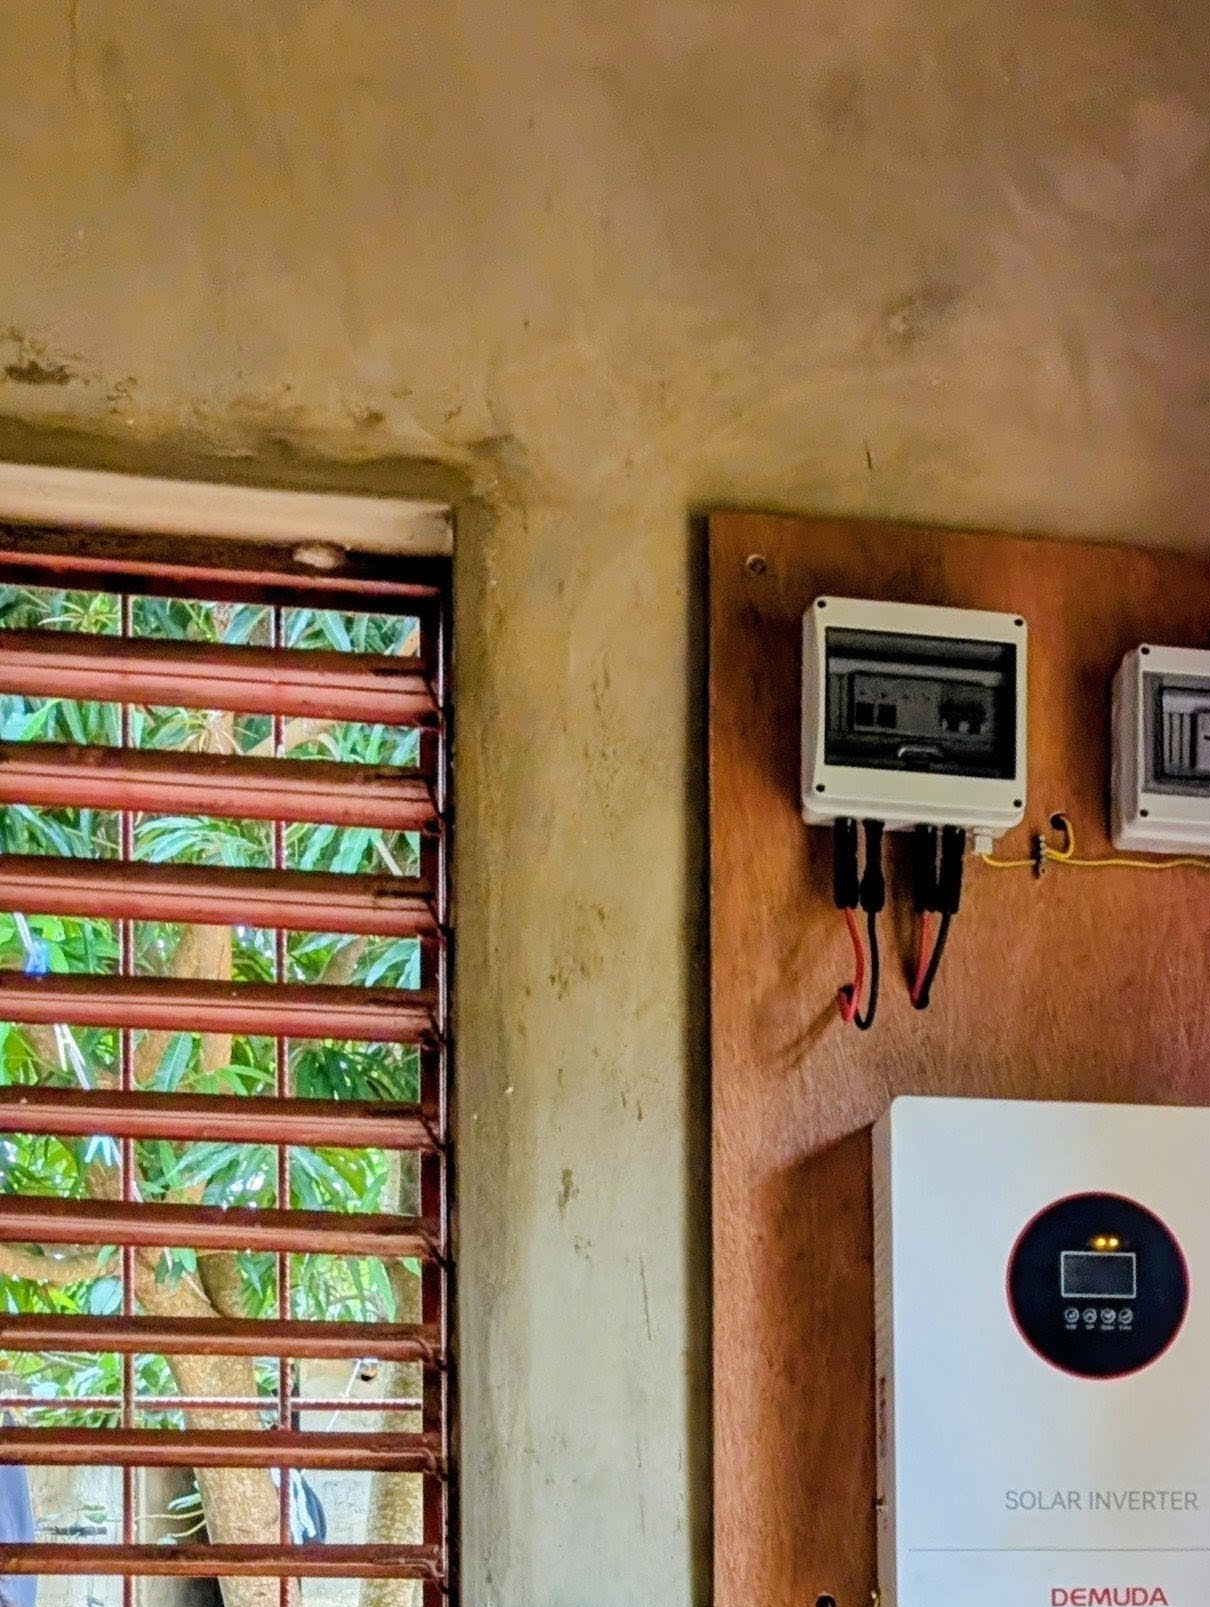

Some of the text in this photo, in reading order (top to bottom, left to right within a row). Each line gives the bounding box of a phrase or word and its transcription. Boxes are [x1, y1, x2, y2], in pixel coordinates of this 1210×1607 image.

[1005, 1490, 1200, 1511] SOLAR INVERTER
[1051, 1587, 1168, 1607] DEMUDA
